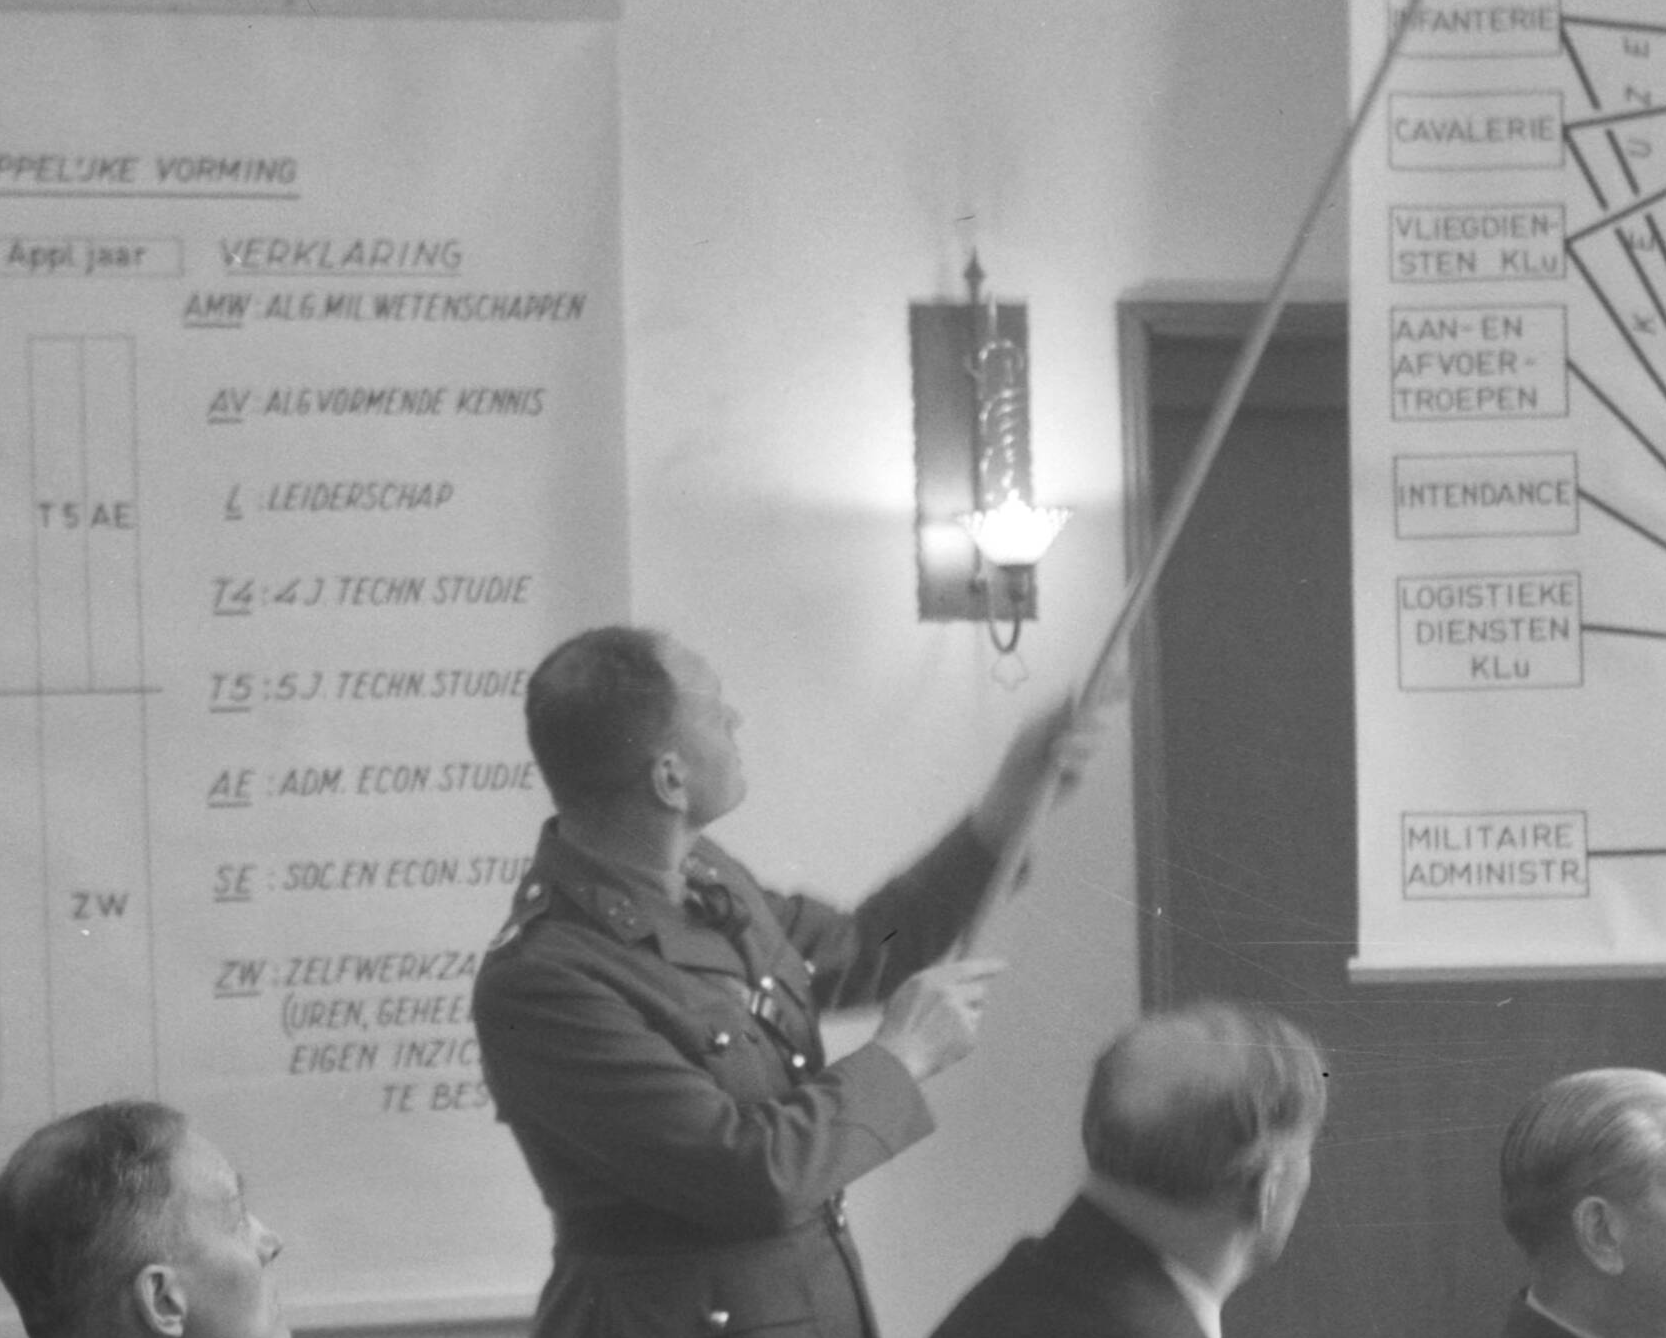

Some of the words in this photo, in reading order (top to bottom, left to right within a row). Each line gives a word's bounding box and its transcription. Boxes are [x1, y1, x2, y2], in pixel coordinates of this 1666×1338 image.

[1391, 6, 1555, 34] IFANTERIE
[1395, 115, 1555, 145] CAVALERIE
[155, 156, 297, 185] VORMING
[221, 238, 463, 270] VERKLARING
[1398, 249, 1478, 276] STEN
[1481, 315, 1524, 341] EN
[454, 387, 546, 417] KENNIS
[1395, 385, 1538, 414] TROEPEN
[268, 480, 456, 512] LEIDERSCHAP
[1397, 480, 1573, 510] INTENDANCE
[432, 574, 533, 605] STUDIE
[1400, 580, 1576, 611] LOGISTIEKE
[1415, 616, 1571, 645] DIENSTEN
[1470, 655, 1531, 680] KLu
[431, 668, 527, 698] STUDIE
[438, 761, 534, 793] STUDIE
[1407, 823, 1575, 851] MILITAIRE
[289, 1043, 380, 1077] EIGEN
[382, 1082, 417, 1113] TE
